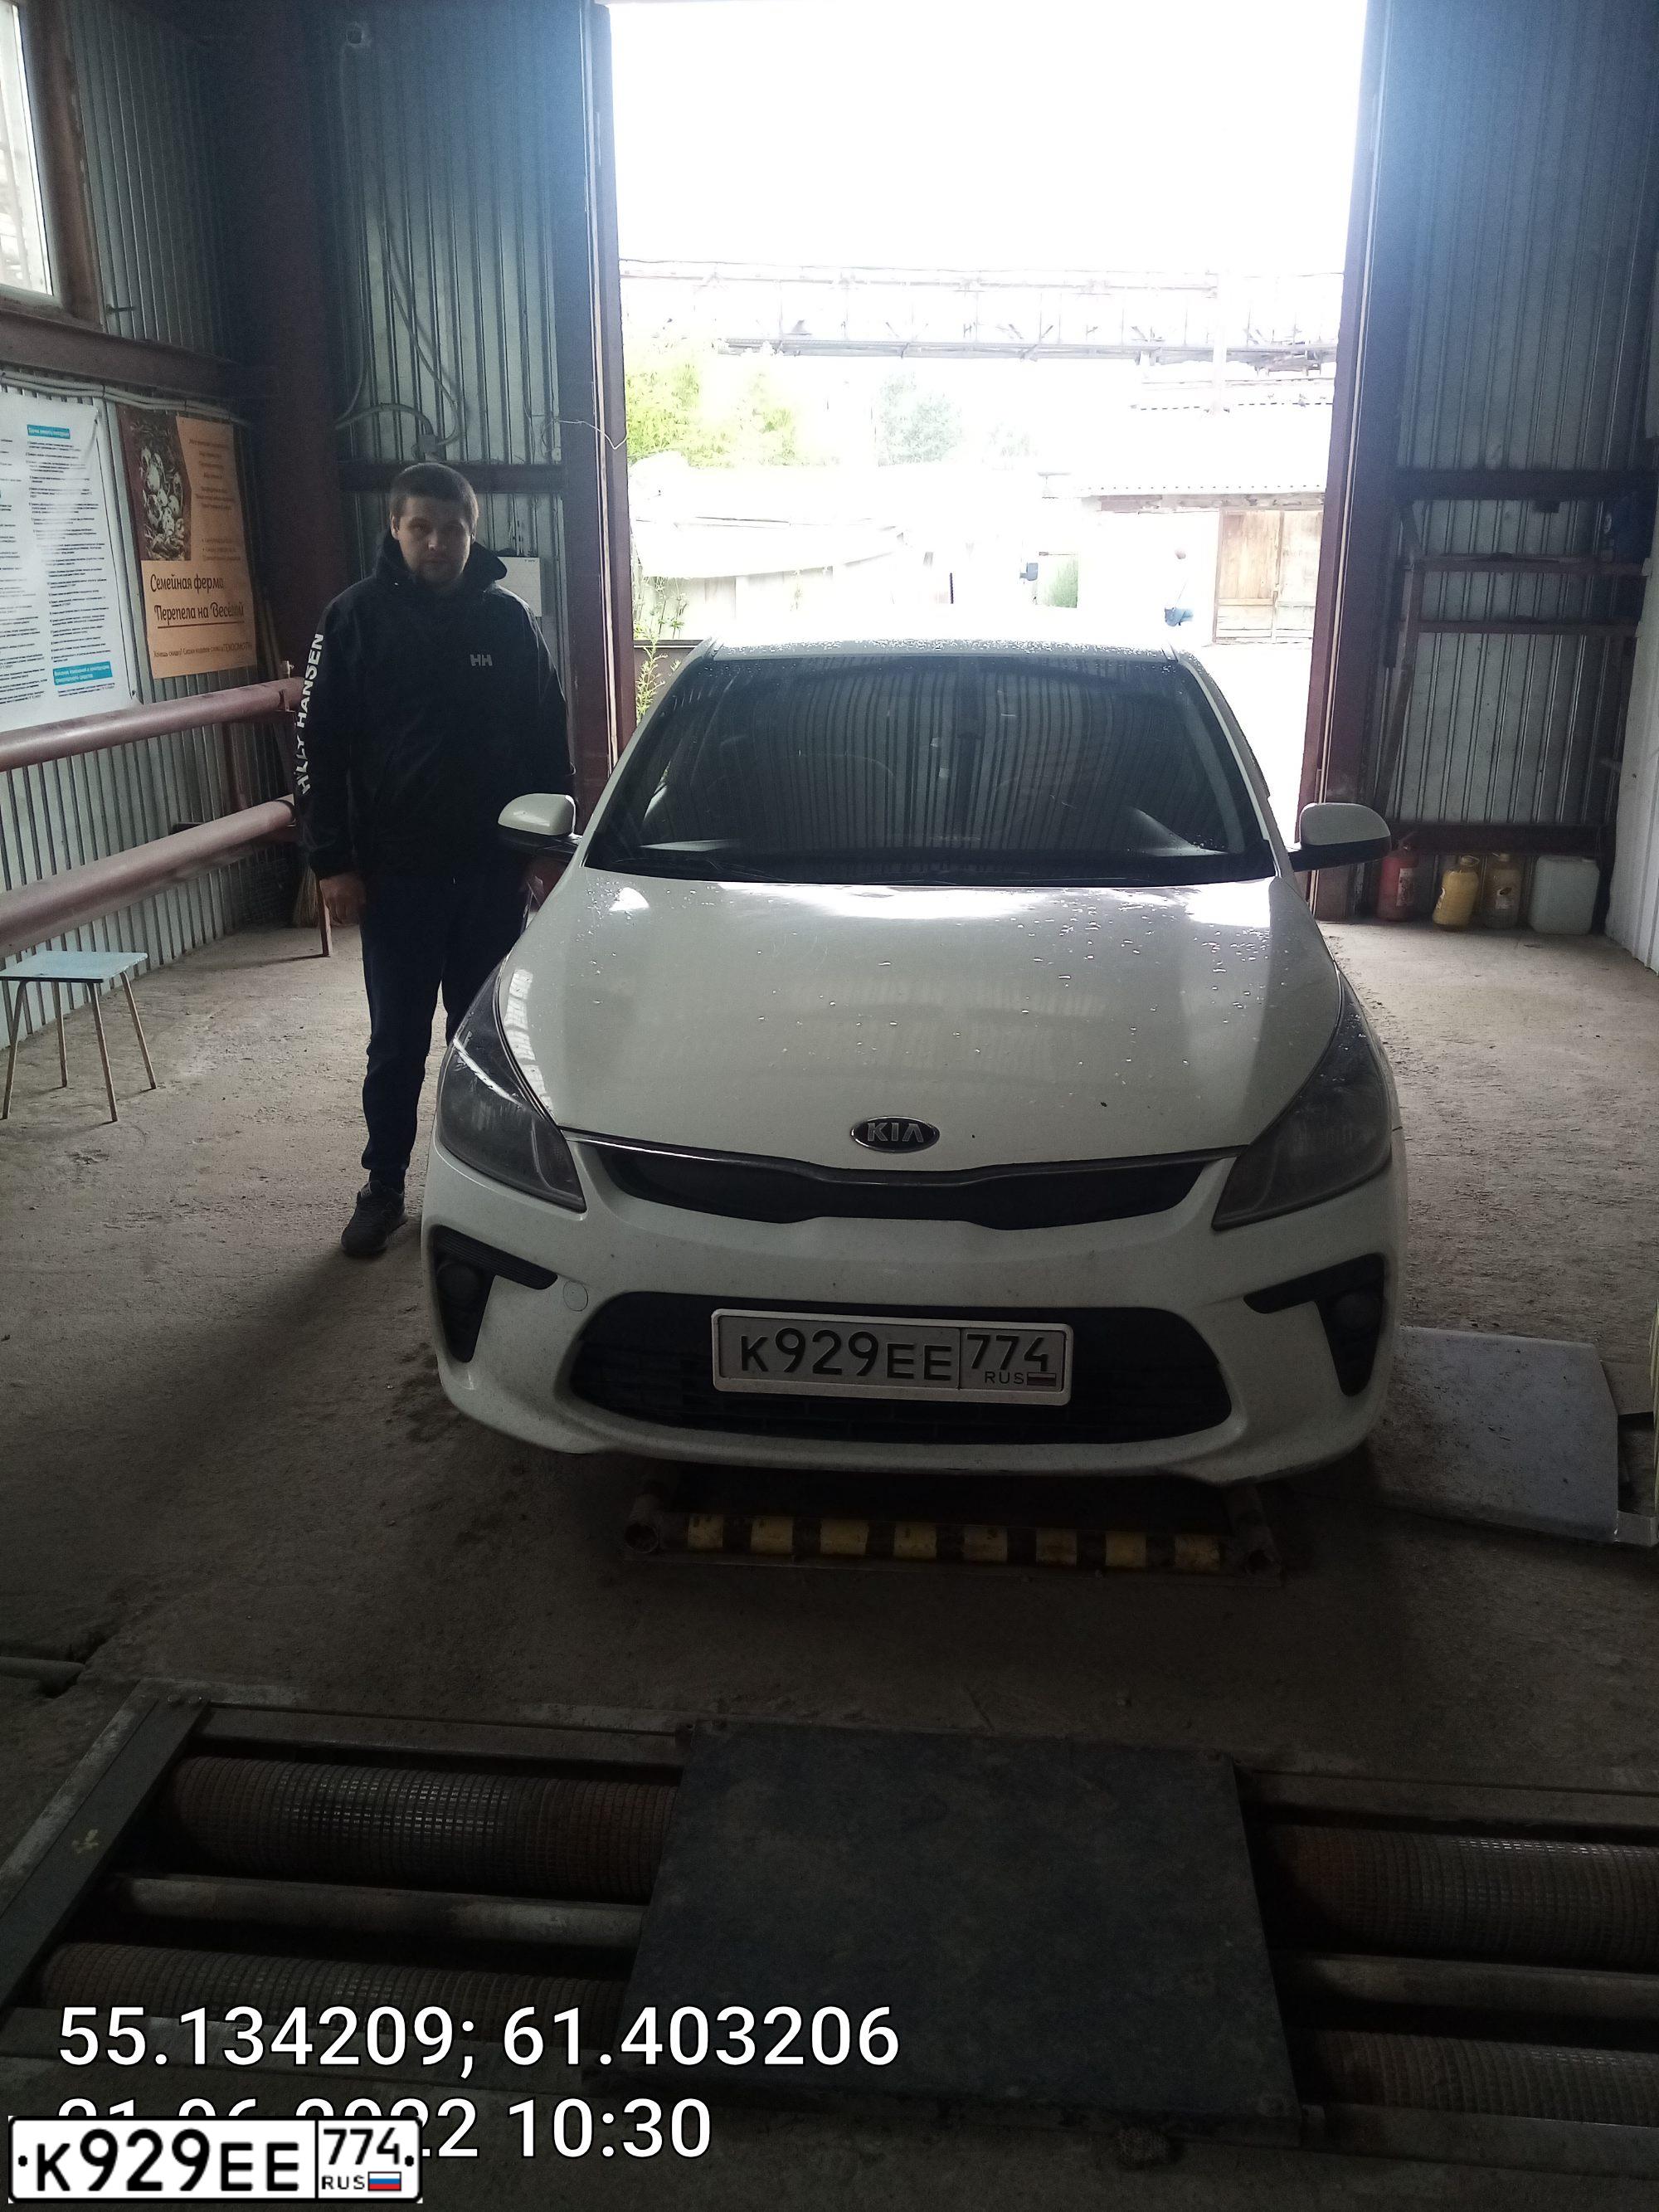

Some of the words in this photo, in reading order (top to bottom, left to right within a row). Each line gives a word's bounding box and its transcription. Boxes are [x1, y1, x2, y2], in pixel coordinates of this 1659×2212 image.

[150, 573, 192, 592] Семейная
[194, 572, 224, 594] ферма
[153, 604, 196, 626] Перепела
[197, 607, 209, 619] на
[469, 654, 493, 667] HH
[296, 633, 324, 728] HANSEN
[867, 1122, 925, 1143] KIA
[966, 1334, 1049, 1372] 774
[984, 1371, 1024, 1385] RUS
